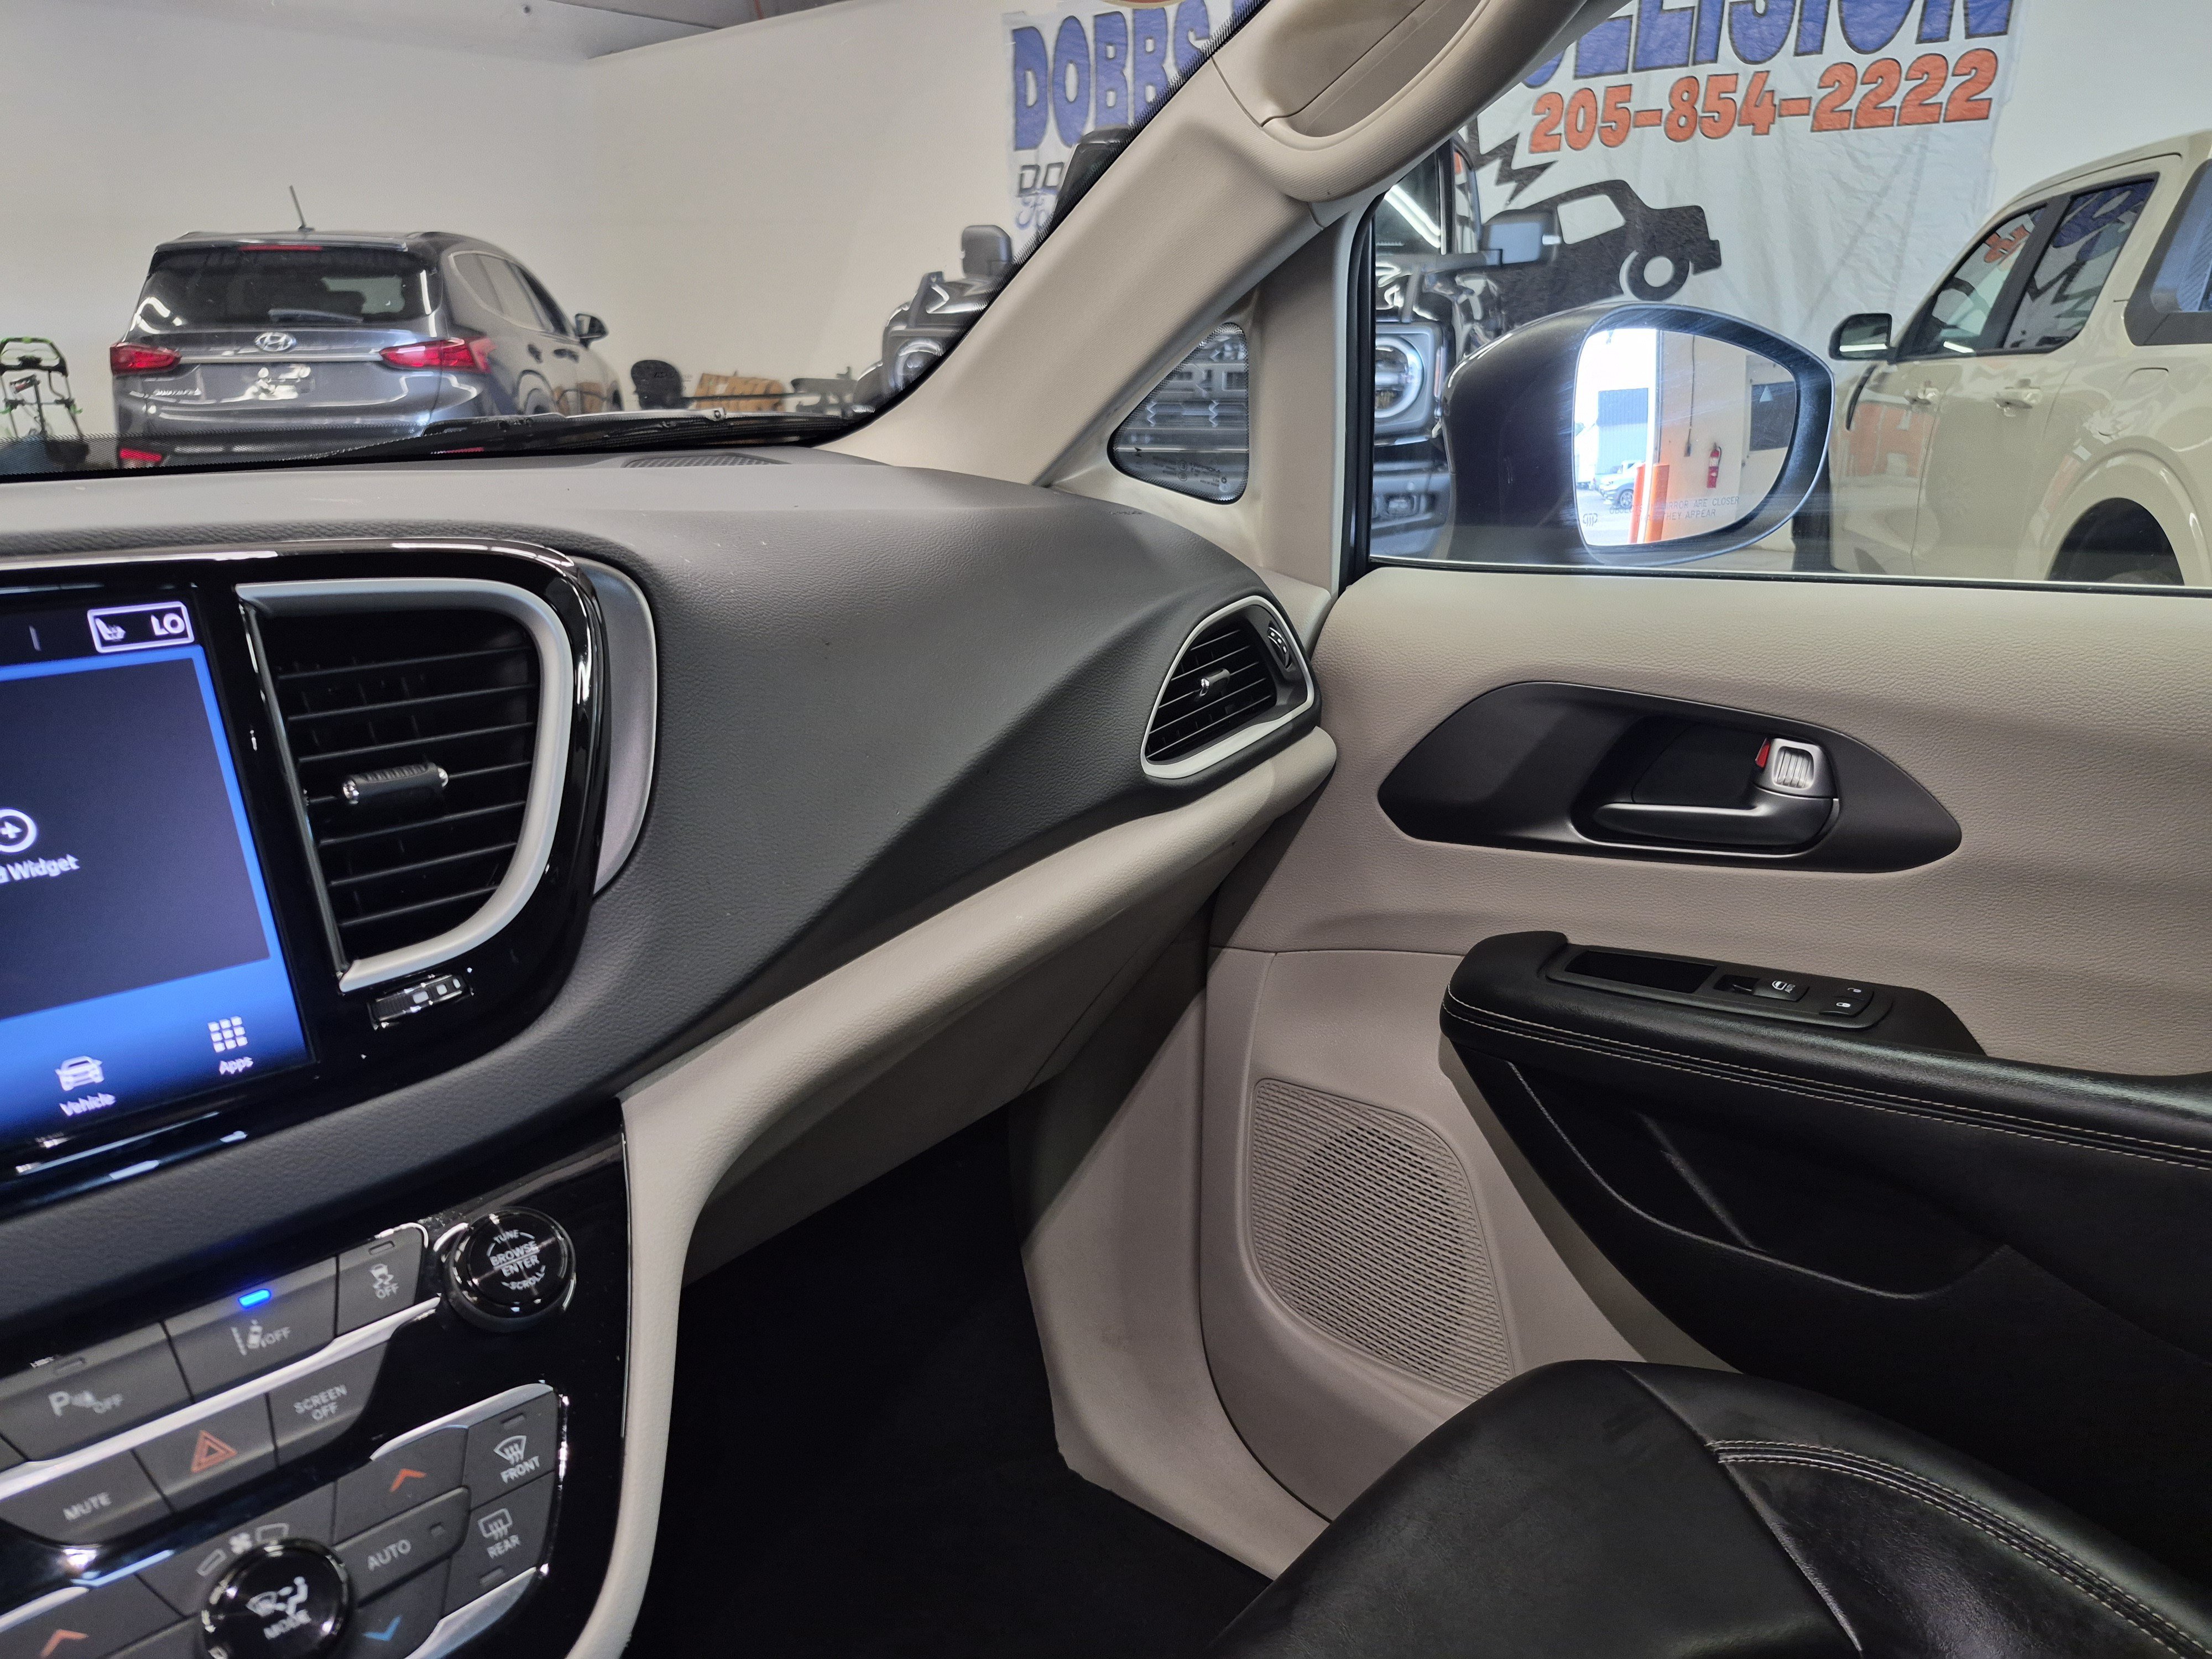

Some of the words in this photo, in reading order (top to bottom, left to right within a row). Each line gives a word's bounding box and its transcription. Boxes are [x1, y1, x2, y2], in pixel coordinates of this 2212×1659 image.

[1528, 48, 1999, 154] 205-854-2222
[1609, 504, 1642, 515] OBJECS
[1693, 499, 1708, 508] ARE
[1712, 496, 1740, 507] CLOSER
[1662, 510, 1682, 521] HEY
[1685, 509, 1717, 519] APPEAR
[150, 613, 185, 637] LO
[7, 854, 80, 881] Widget
[219, 1057, 253, 1074] Apps
[59, 1092, 116, 1116] Vehicle
[494, 1229, 519, 1244] TUNE
[489, 1241, 539, 1267] BROWSE
[501, 1255, 540, 1277] ENTER
[376, 1283, 399, 1299] OFF
[509, 1271, 545, 1290] SCROLL
[265, 1327, 291, 1345] OFF
[293, 1384, 347, 1415] SCREEN
[311, 1401, 338, 1421] OFF
[500, 1455, 540, 1484] FRONT
[62, 1492, 111, 1521] MUTE
[367, 1538, 411, 1571] AUTO
[487, 1534, 520, 1559] REAR
